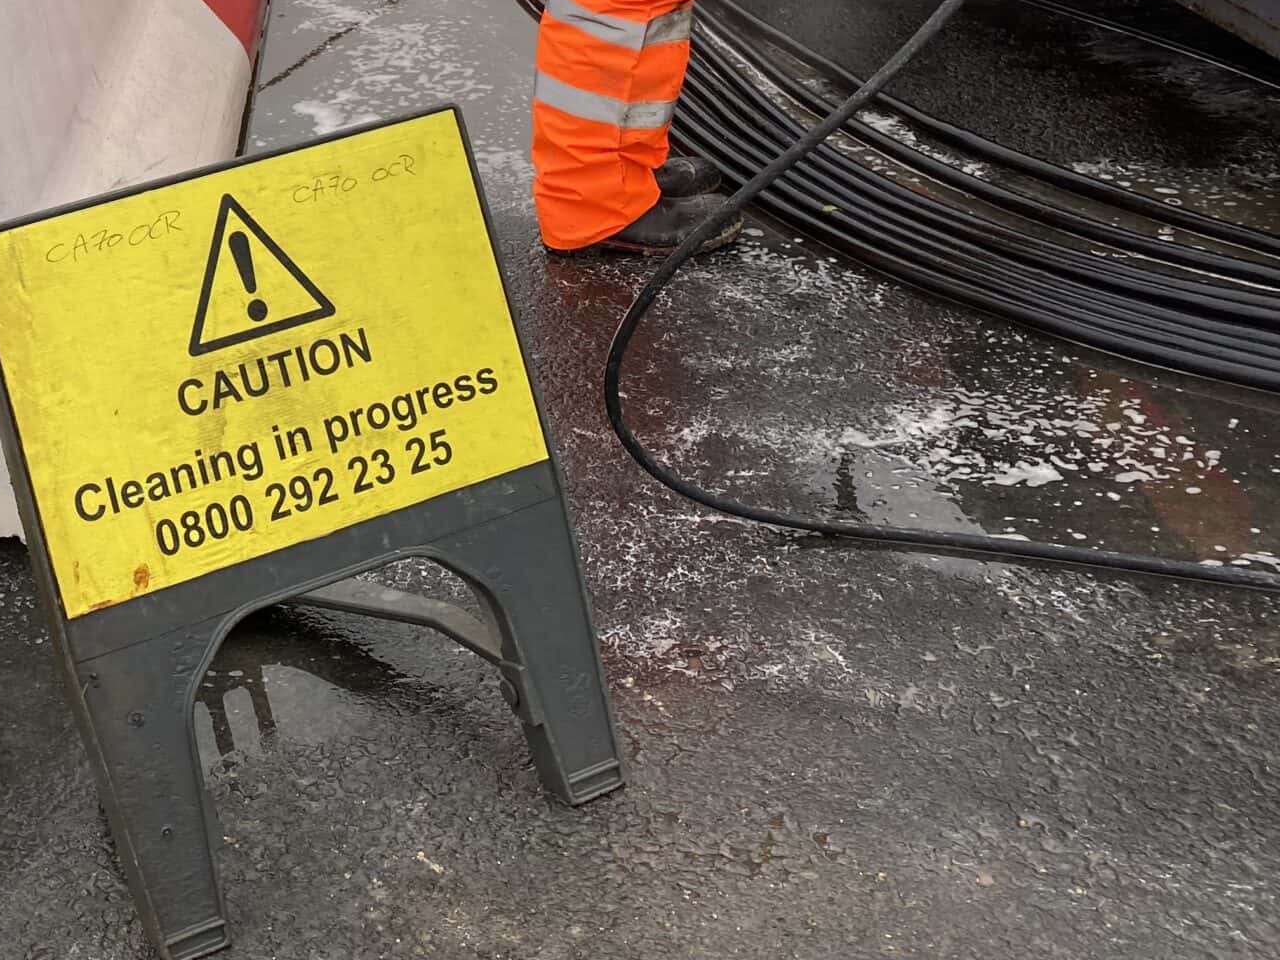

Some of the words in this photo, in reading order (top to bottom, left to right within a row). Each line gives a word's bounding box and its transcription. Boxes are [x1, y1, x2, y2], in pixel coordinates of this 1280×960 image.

[293, 175, 358, 203] CA70
[177, 327, 373, 416] CAUTION
[74, 441, 265, 522] Cleaning
[271, 425, 313, 461] in
[323, 367, 498, 454] progress
[155, 494, 254, 556] 0800
[264, 467, 340, 521] 292
[347, 448, 396, 494] 23
[405, 429, 453, 475] 25
